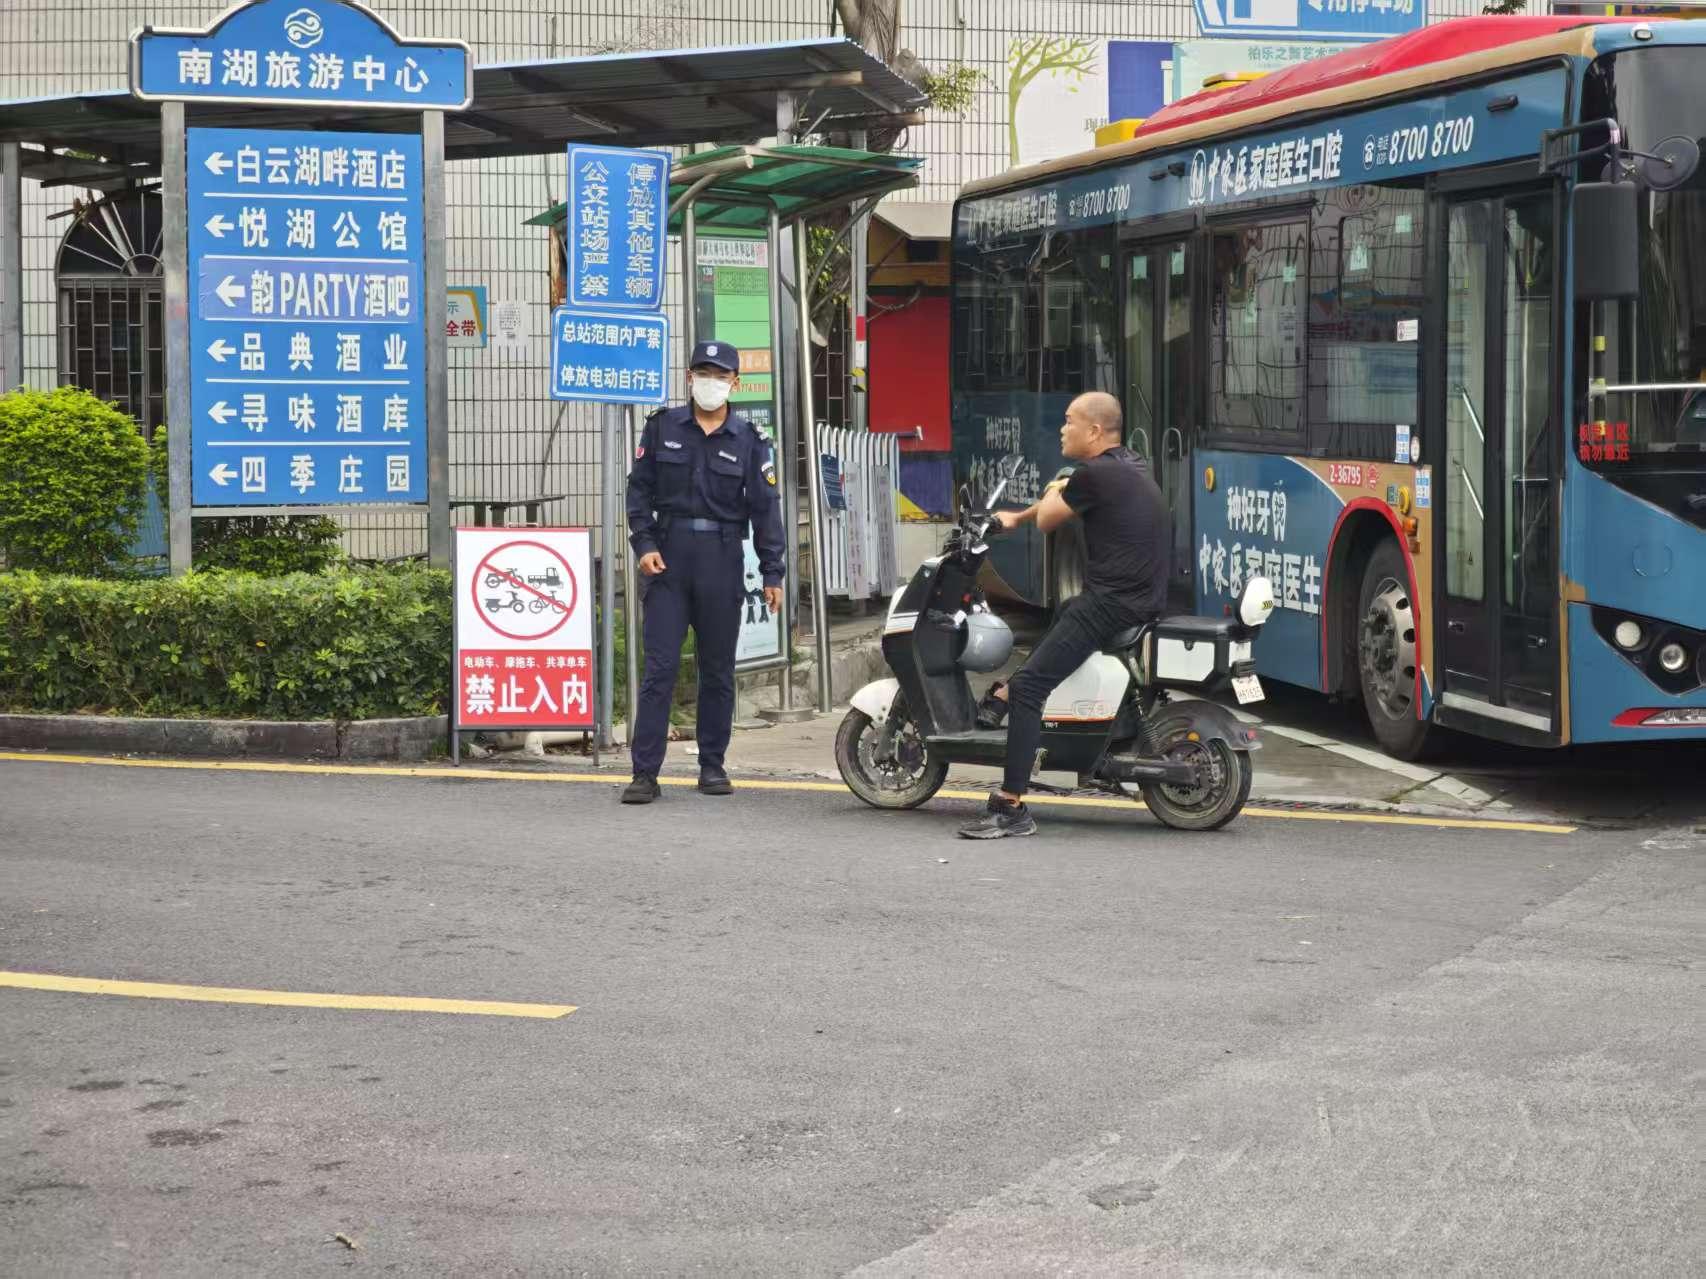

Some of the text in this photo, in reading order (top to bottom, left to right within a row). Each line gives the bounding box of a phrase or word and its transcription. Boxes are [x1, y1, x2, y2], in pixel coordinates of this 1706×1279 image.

[177, 48, 429, 93] 南湖旅游中心
[1389, 125, 1428, 165] 8700
[1431, 115, 1474, 157] 8700
[236, 145, 406, 189] 白云湖畔酒店
[1083, 190, 1105, 217] 8700
[1106, 184, 1130, 213] 8700
[238, 206, 408, 251] 悦湖公馆
[580, 161, 609, 297] 公交站场严禁
[625, 163, 656, 298] 停放其他车辆
[240, 332, 408, 372] 品典酒业
[562, 321, 660, 349] 总站范围内严禁
[561, 364, 660, 391] 停放电动自行车
[241, 393, 409, 433] 寻味酒库
[241, 454, 410, 494] 四季庄园
[465, 674, 587, 714] 禁止入内
